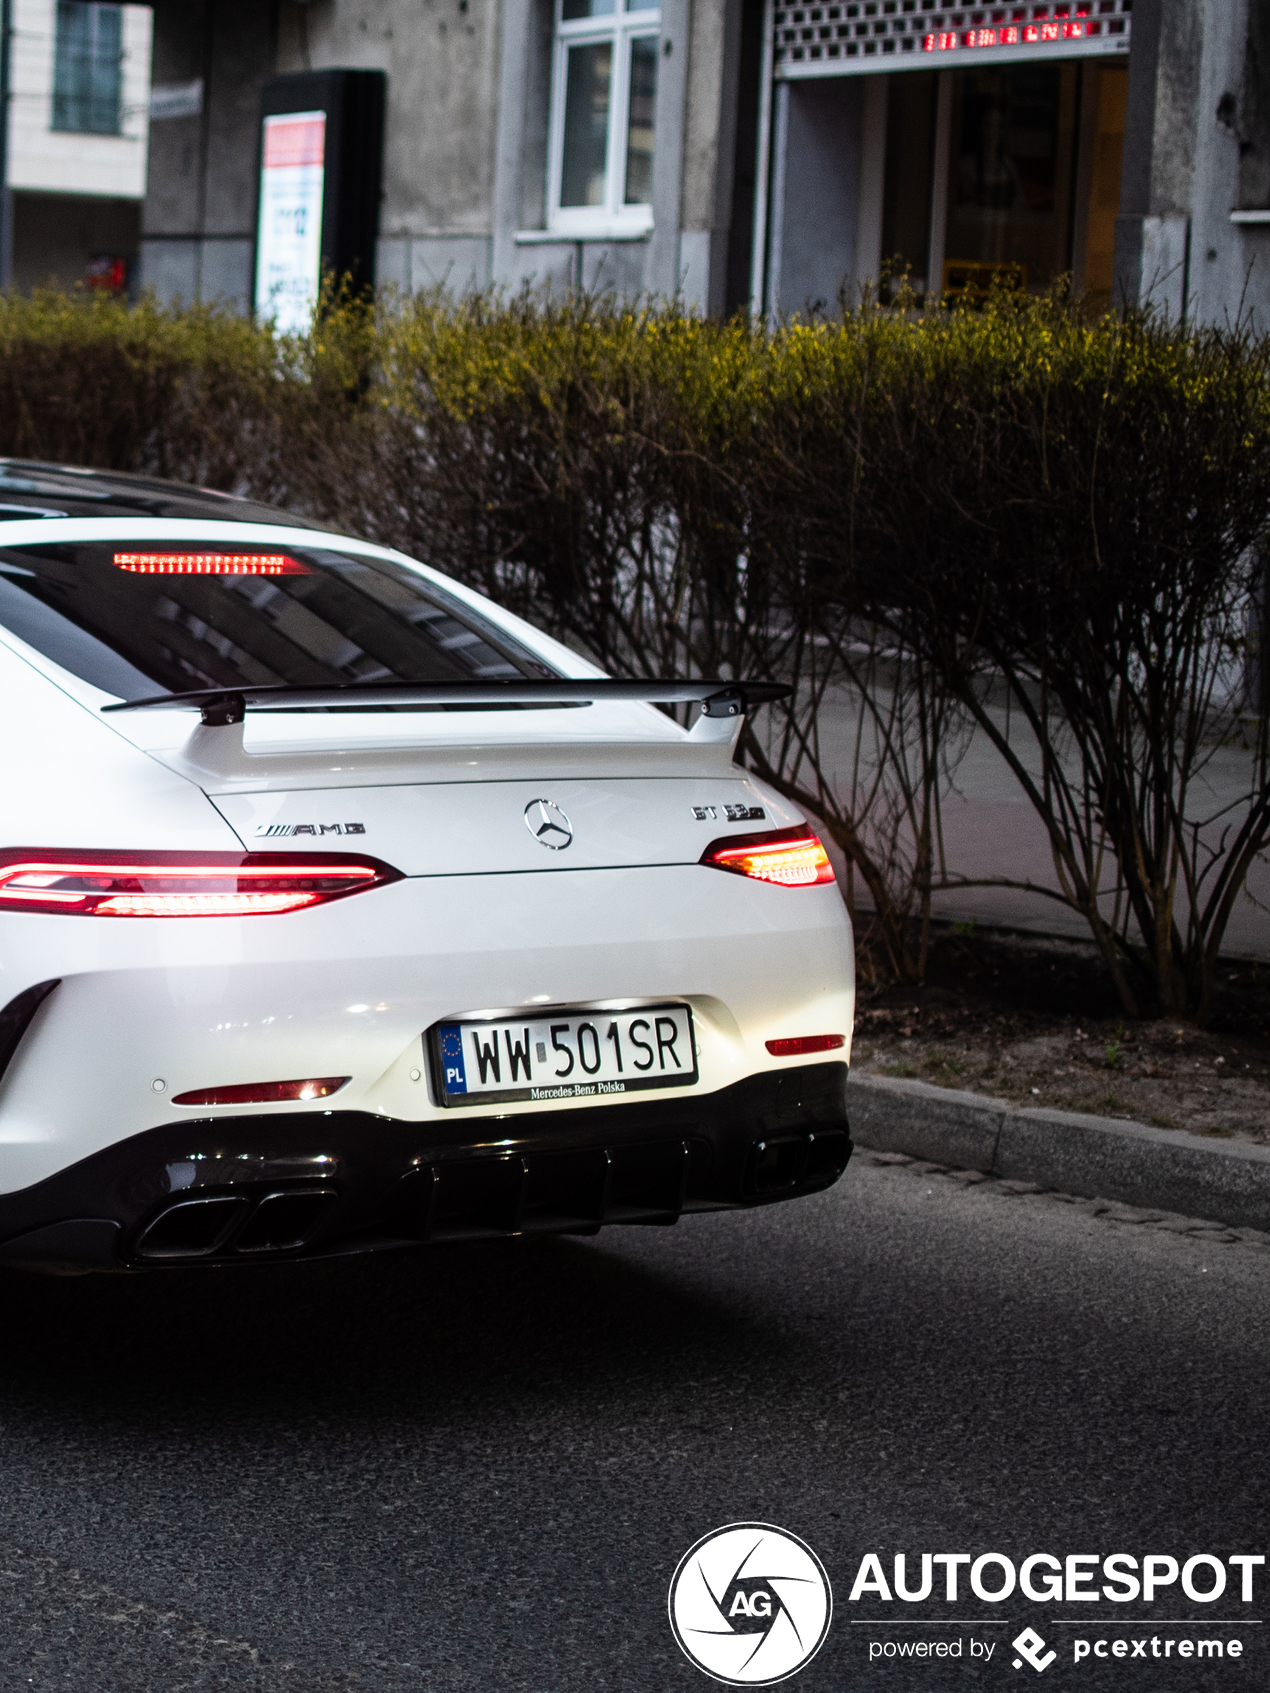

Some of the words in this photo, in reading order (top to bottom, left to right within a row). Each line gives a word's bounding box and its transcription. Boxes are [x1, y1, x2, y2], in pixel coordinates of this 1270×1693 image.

[290, 822, 366, 837] AMG
[472, 1026, 533, 1085] WW
[549, 1016, 683, 1078] 501SR
[446, 1067, 464, 1084] PL
[530, 1082, 596, 1100] Mercedes-Benz
[598, 1080, 626, 1094] Polska
